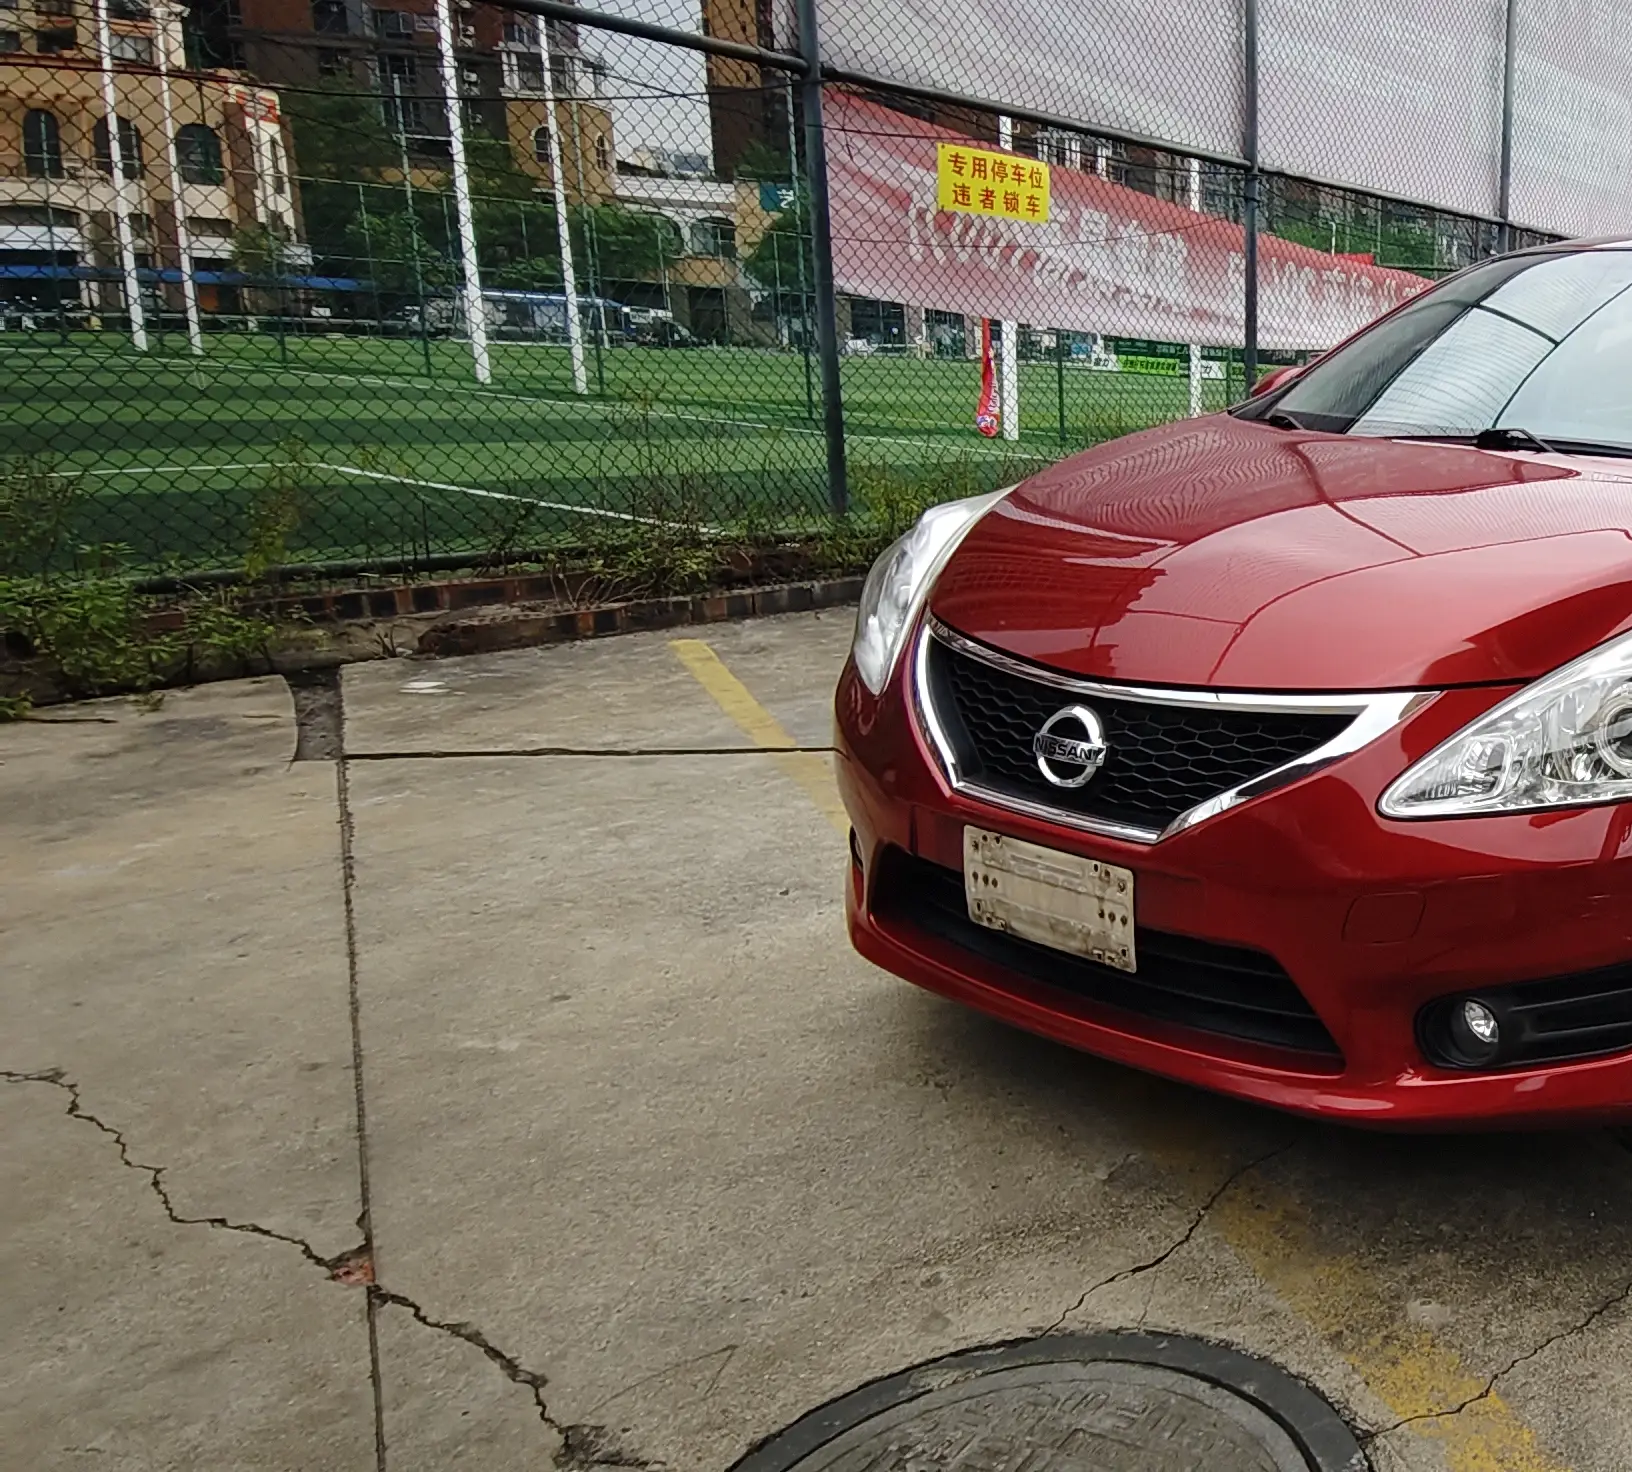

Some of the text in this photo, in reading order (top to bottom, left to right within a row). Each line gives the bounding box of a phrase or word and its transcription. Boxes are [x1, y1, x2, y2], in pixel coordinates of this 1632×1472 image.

[947, 151, 1044, 189] 专用停车位
[952, 182, 1041, 217] 违者锁车
[1034, 735, 1095, 762] NISSAN
